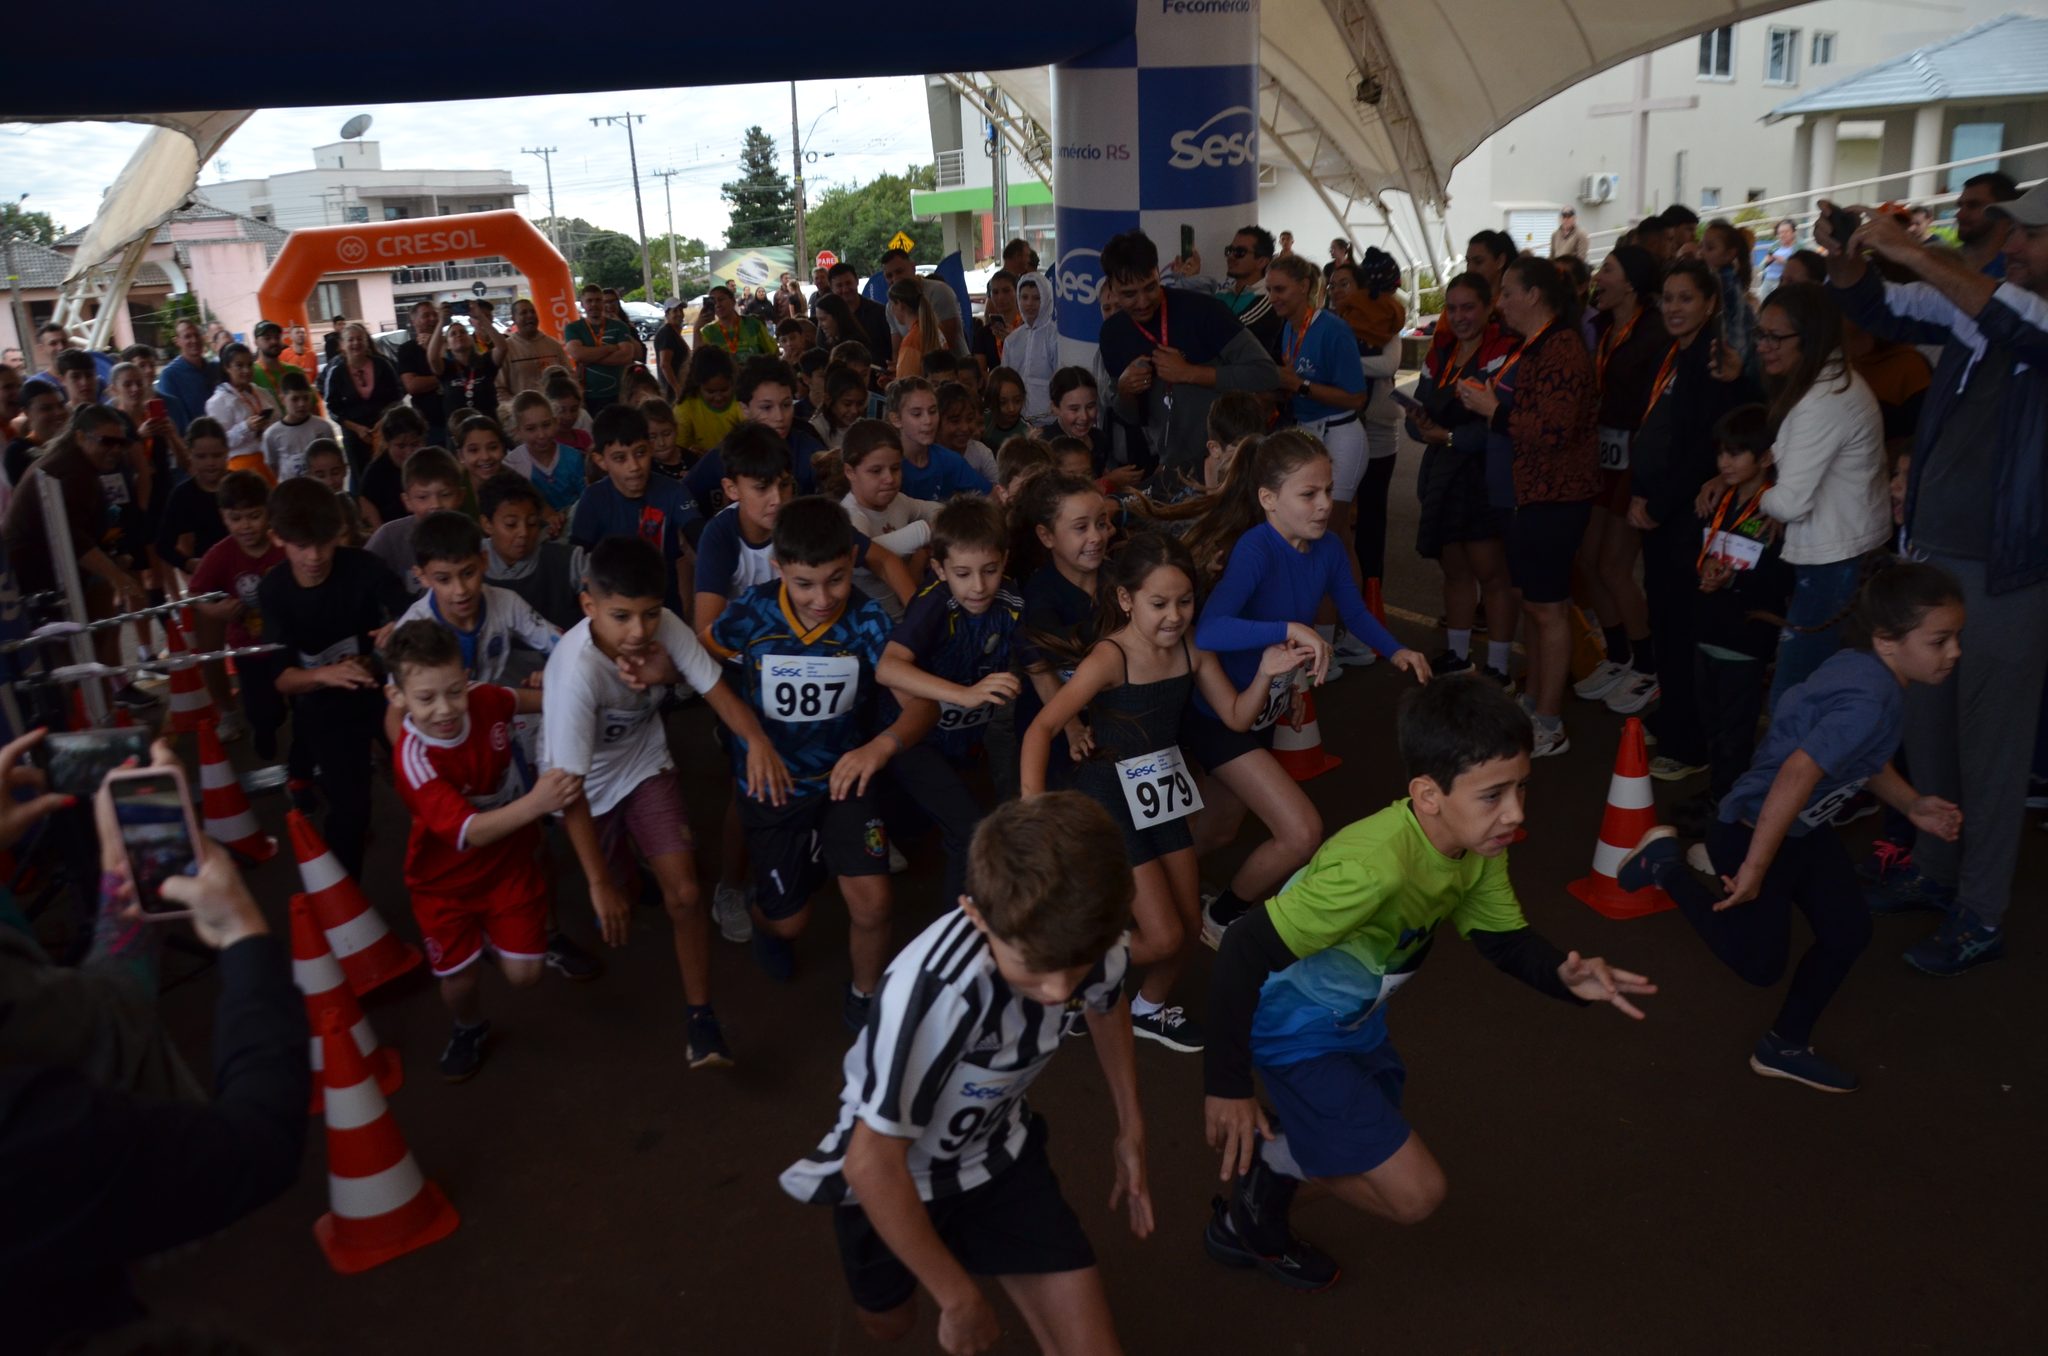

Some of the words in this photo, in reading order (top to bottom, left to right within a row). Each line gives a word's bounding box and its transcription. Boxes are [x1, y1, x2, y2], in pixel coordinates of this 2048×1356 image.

[1058, 143, 1101, 160] mércio
[1106, 143, 1130, 161] RS
[376, 229, 487, 257] CRESOL
[775, 682, 846, 716] 987
[1136, 771, 1193, 819] 979
